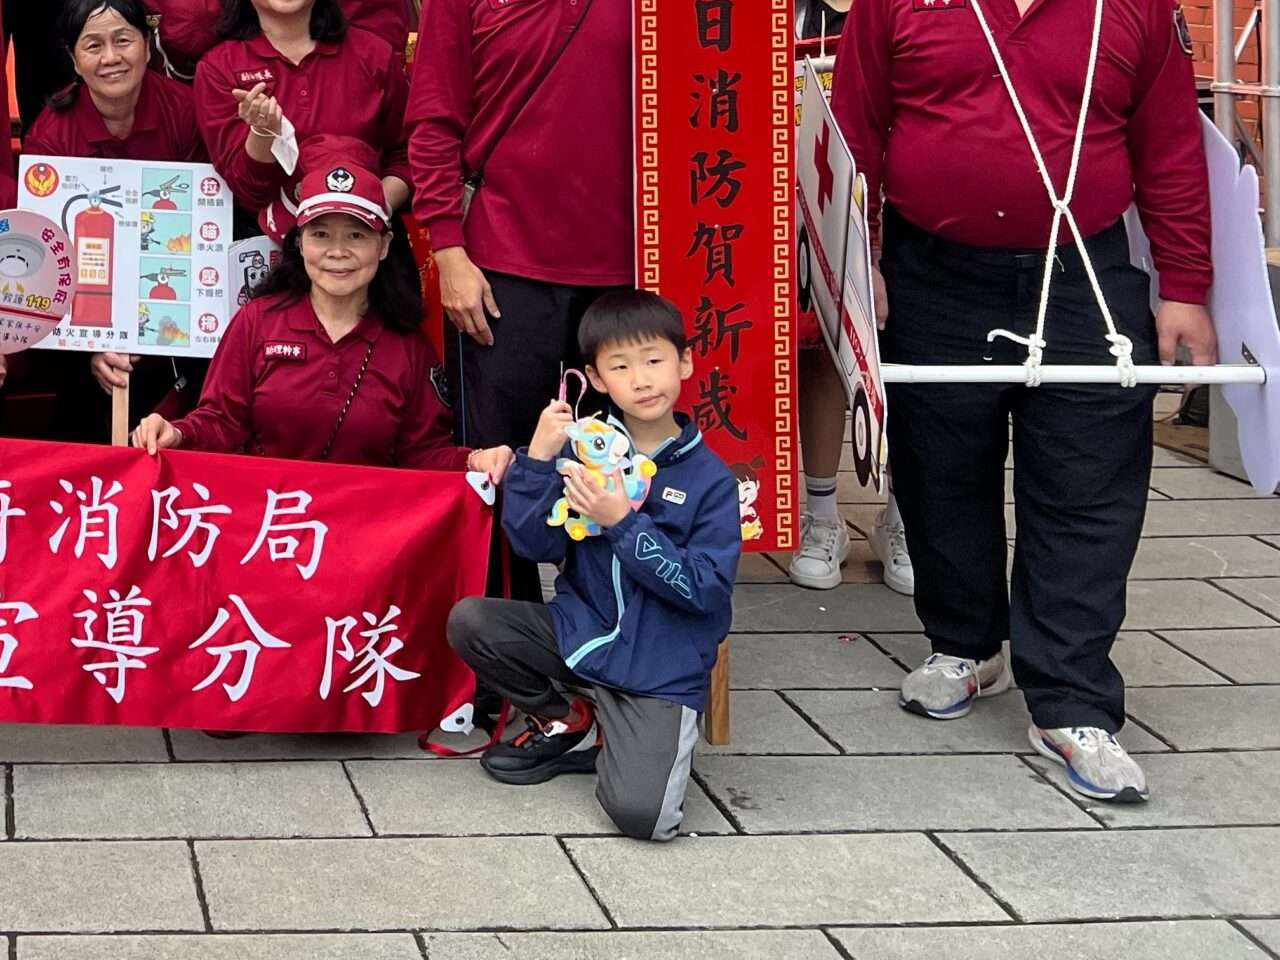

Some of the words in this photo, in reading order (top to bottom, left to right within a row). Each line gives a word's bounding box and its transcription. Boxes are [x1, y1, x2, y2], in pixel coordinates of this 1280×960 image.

[26, 293, 52, 311] 119
[52, 327, 129, 340] 防火宣導分隊
